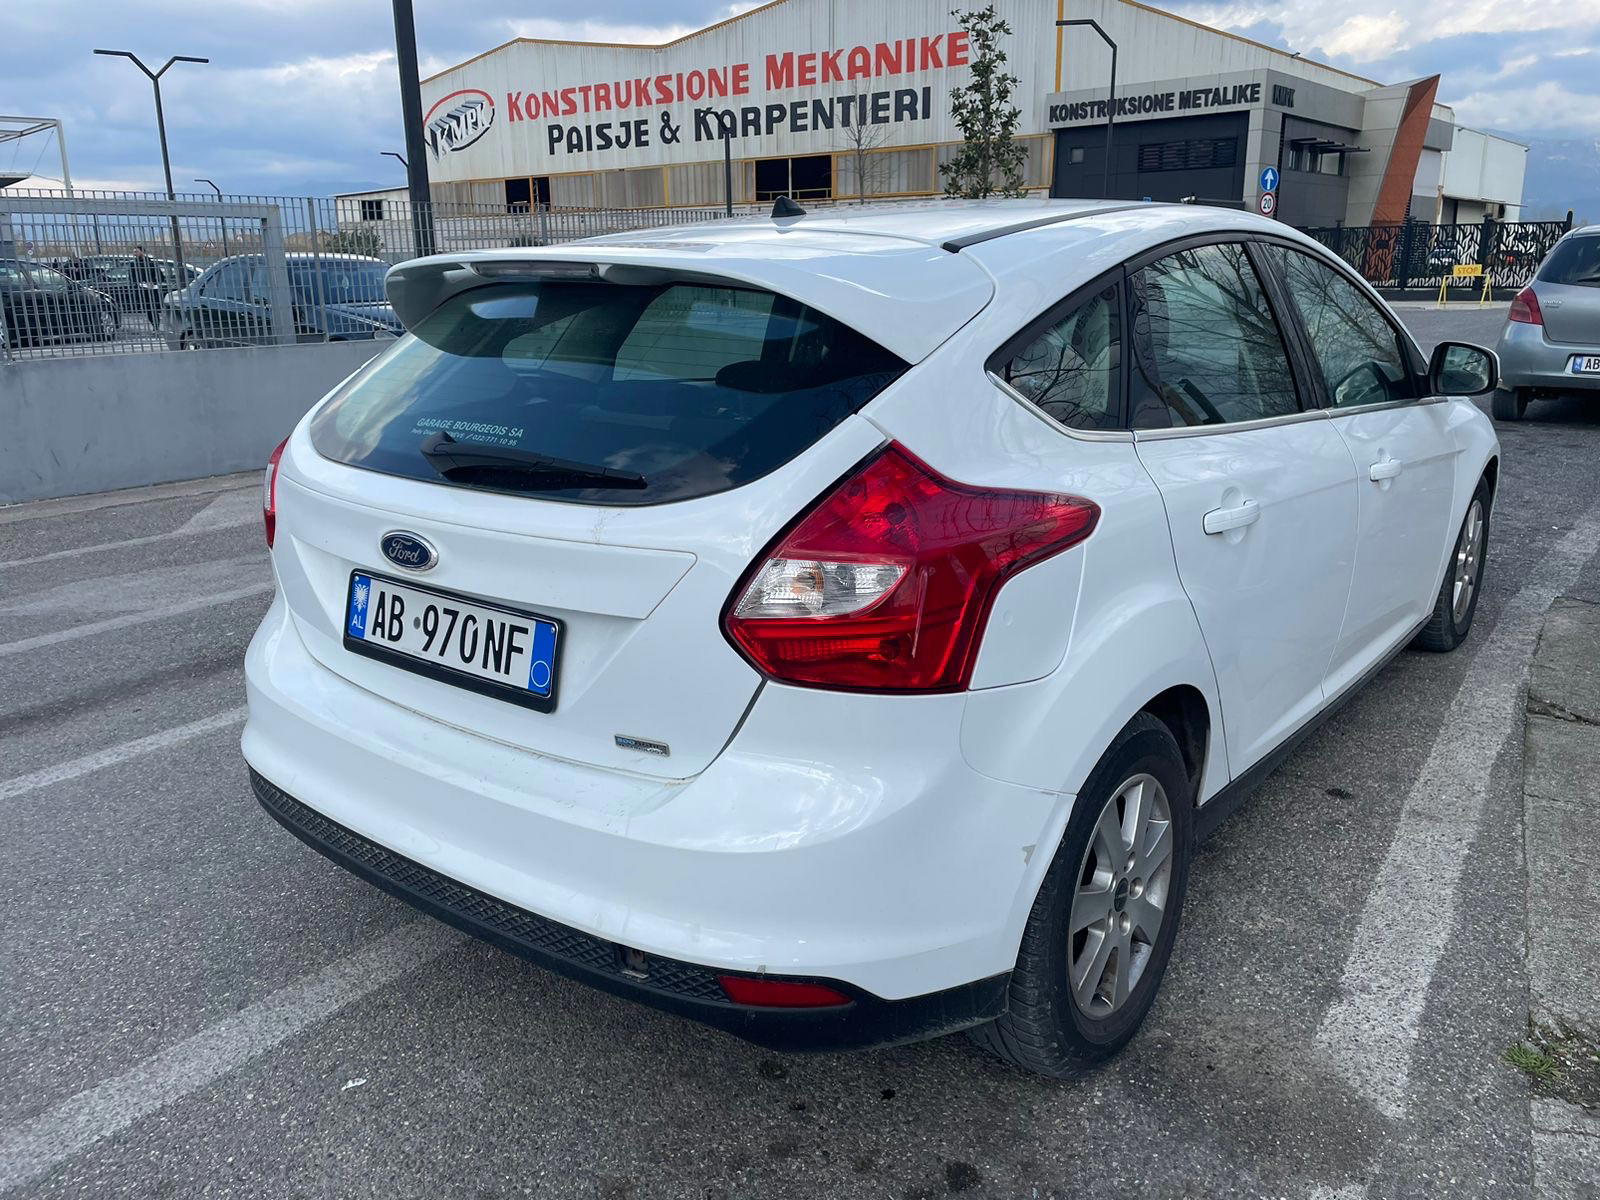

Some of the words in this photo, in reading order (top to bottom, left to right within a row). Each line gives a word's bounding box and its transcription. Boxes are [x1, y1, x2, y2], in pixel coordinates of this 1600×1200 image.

[507, 63, 749, 122] KONSTRUKSIONE
[765, 31, 969, 91] MEKANIKE
[1049, 93, 1175, 122] KONSTRUKSIONE
[1178, 83, 1261, 110] METALIKE
[548, 119, 649, 155] PAISJE
[660, 113, 681, 145] &
[694, 86, 932, 142] KARPENTIERI
[1262, 198, 1273, 210] 20
[1456, 266, 1479, 275] STOP
[416, 418, 453, 429] GARAGE
[453, 421, 508, 436] BOURGEOIS
[508, 427, 524, 438] SA
[388, 537, 420, 562] Ford
[351, 614, 364, 630] AL
[371, 590, 405, 643] AB
